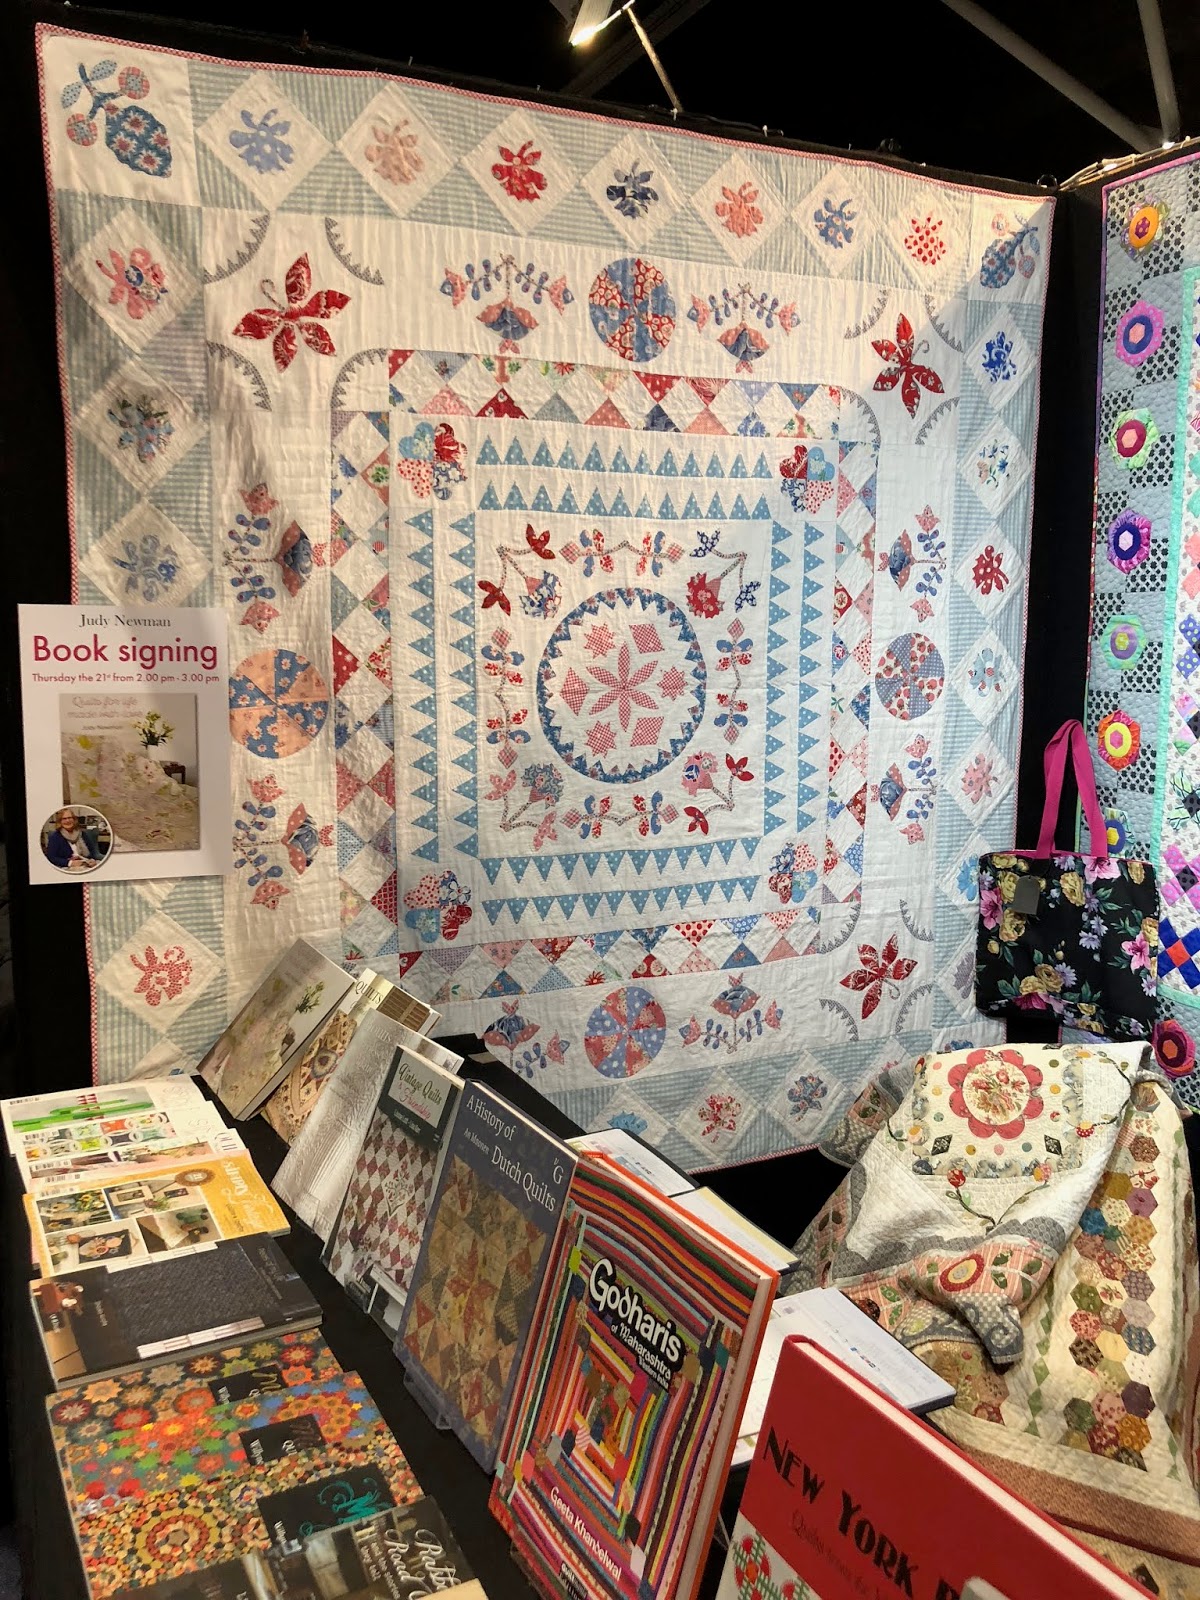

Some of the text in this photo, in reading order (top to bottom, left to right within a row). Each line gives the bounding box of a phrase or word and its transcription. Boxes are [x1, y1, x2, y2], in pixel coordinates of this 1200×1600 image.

[79, 614, 171, 628] Judy Newman
[33, 634, 217, 670] Book signing
[32, 673, 76, 684] Thursday
[78, 673, 93, 682] the
[112, 673, 134, 682] from
[136, 673, 158, 682] 2.00
[160, 675, 175, 684] pm
[181, 673, 203, 682] 3.00
[205, 675, 220, 684] pm
[355, 980, 384, 1005] QUILTS
[398, 1063, 422, 1095] Vintage
[422, 1081, 442, 1106] Quilts
[466, 1095, 517, 1141] A History of
[491, 1145, 522, 1184] Dutch
[522, 1172, 556, 1211] Quilts
[589, 1258, 682, 1363] Godharis
[611, 1322, 672, 1381] of Maharashtra
[550, 1486, 622, 1582] Geeta Khandelwal
[763, 1425, 919, 1600] NEW YORK
[360, 1545, 381, 1582] they tell
[370, 1542, 401, 1600] and the stories
[384, 1529, 430, 1588] Road
